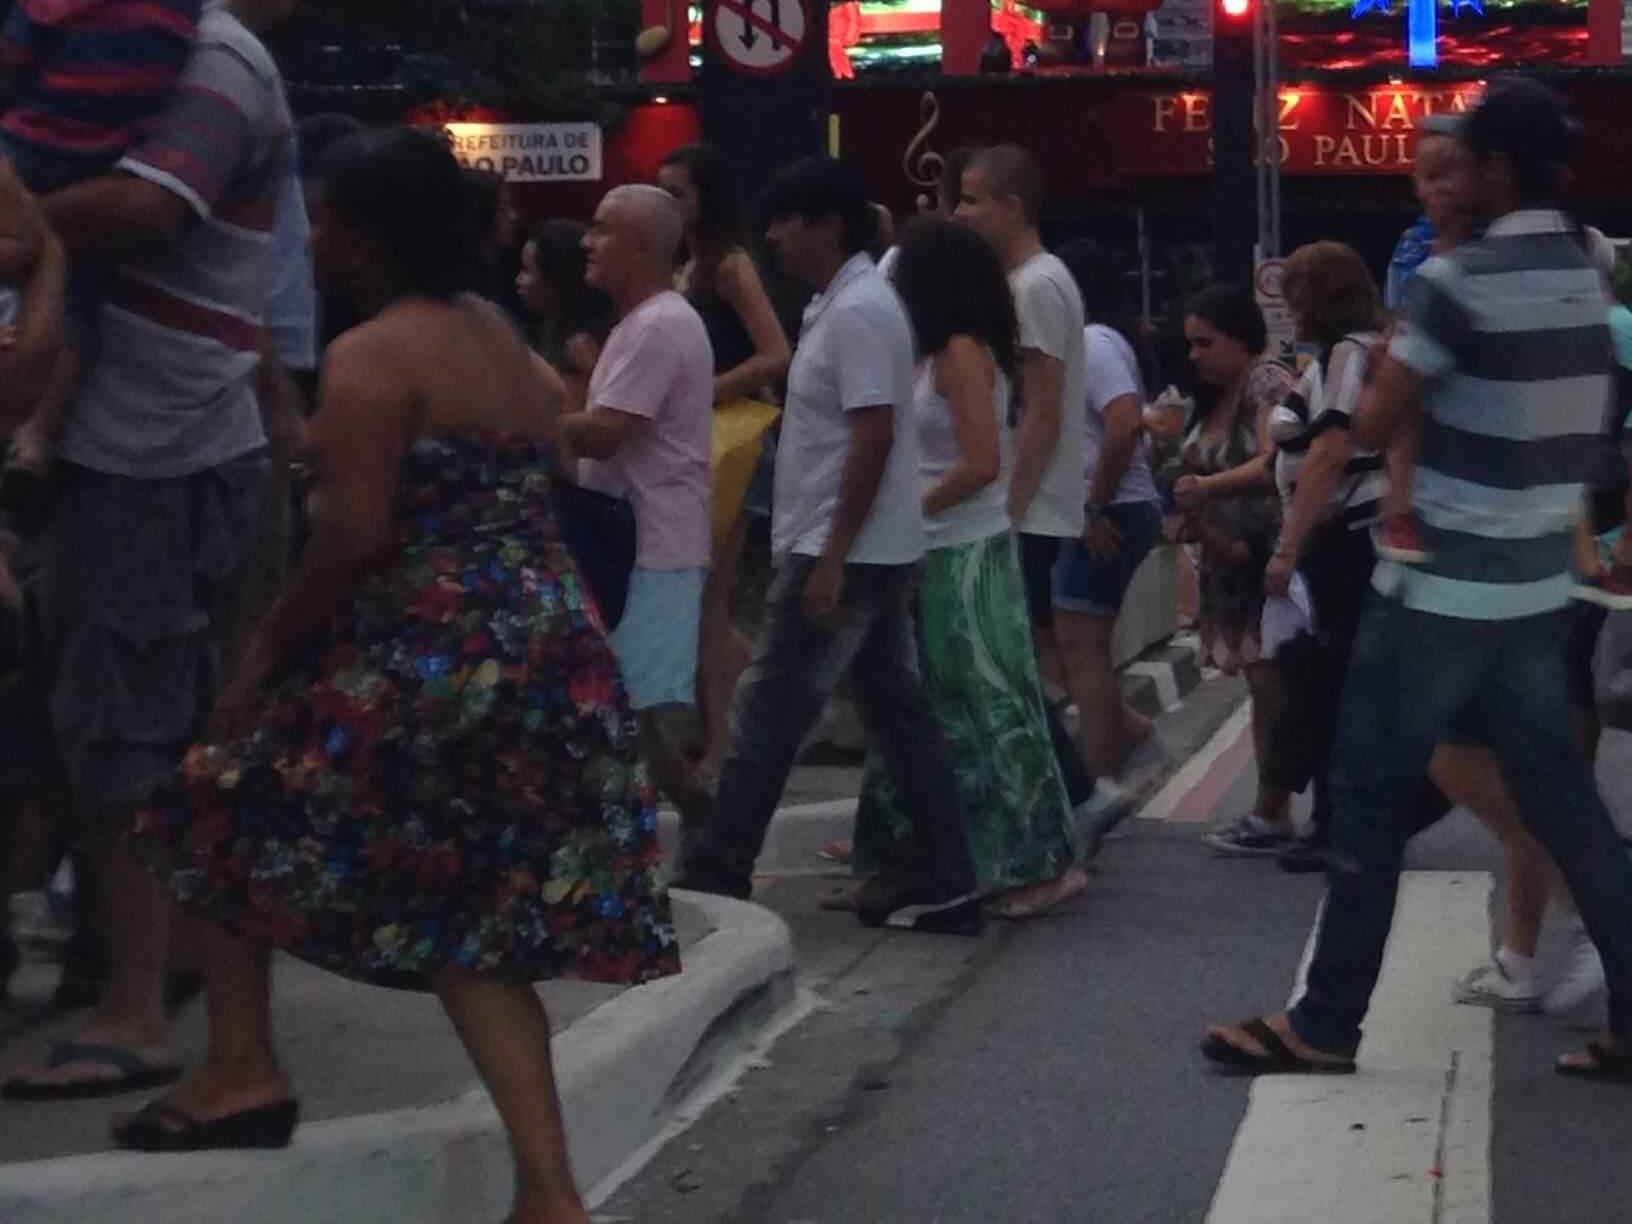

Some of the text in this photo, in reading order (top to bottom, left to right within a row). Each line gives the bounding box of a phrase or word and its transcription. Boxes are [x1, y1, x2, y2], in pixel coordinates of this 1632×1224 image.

[1152, 92, 1468, 133] FEZ NATA
[453, 132, 589, 151] REFEITURA DE
[1313, 134, 1417, 166] PAUL
[458, 152, 590, 176] ÃO PAULO
